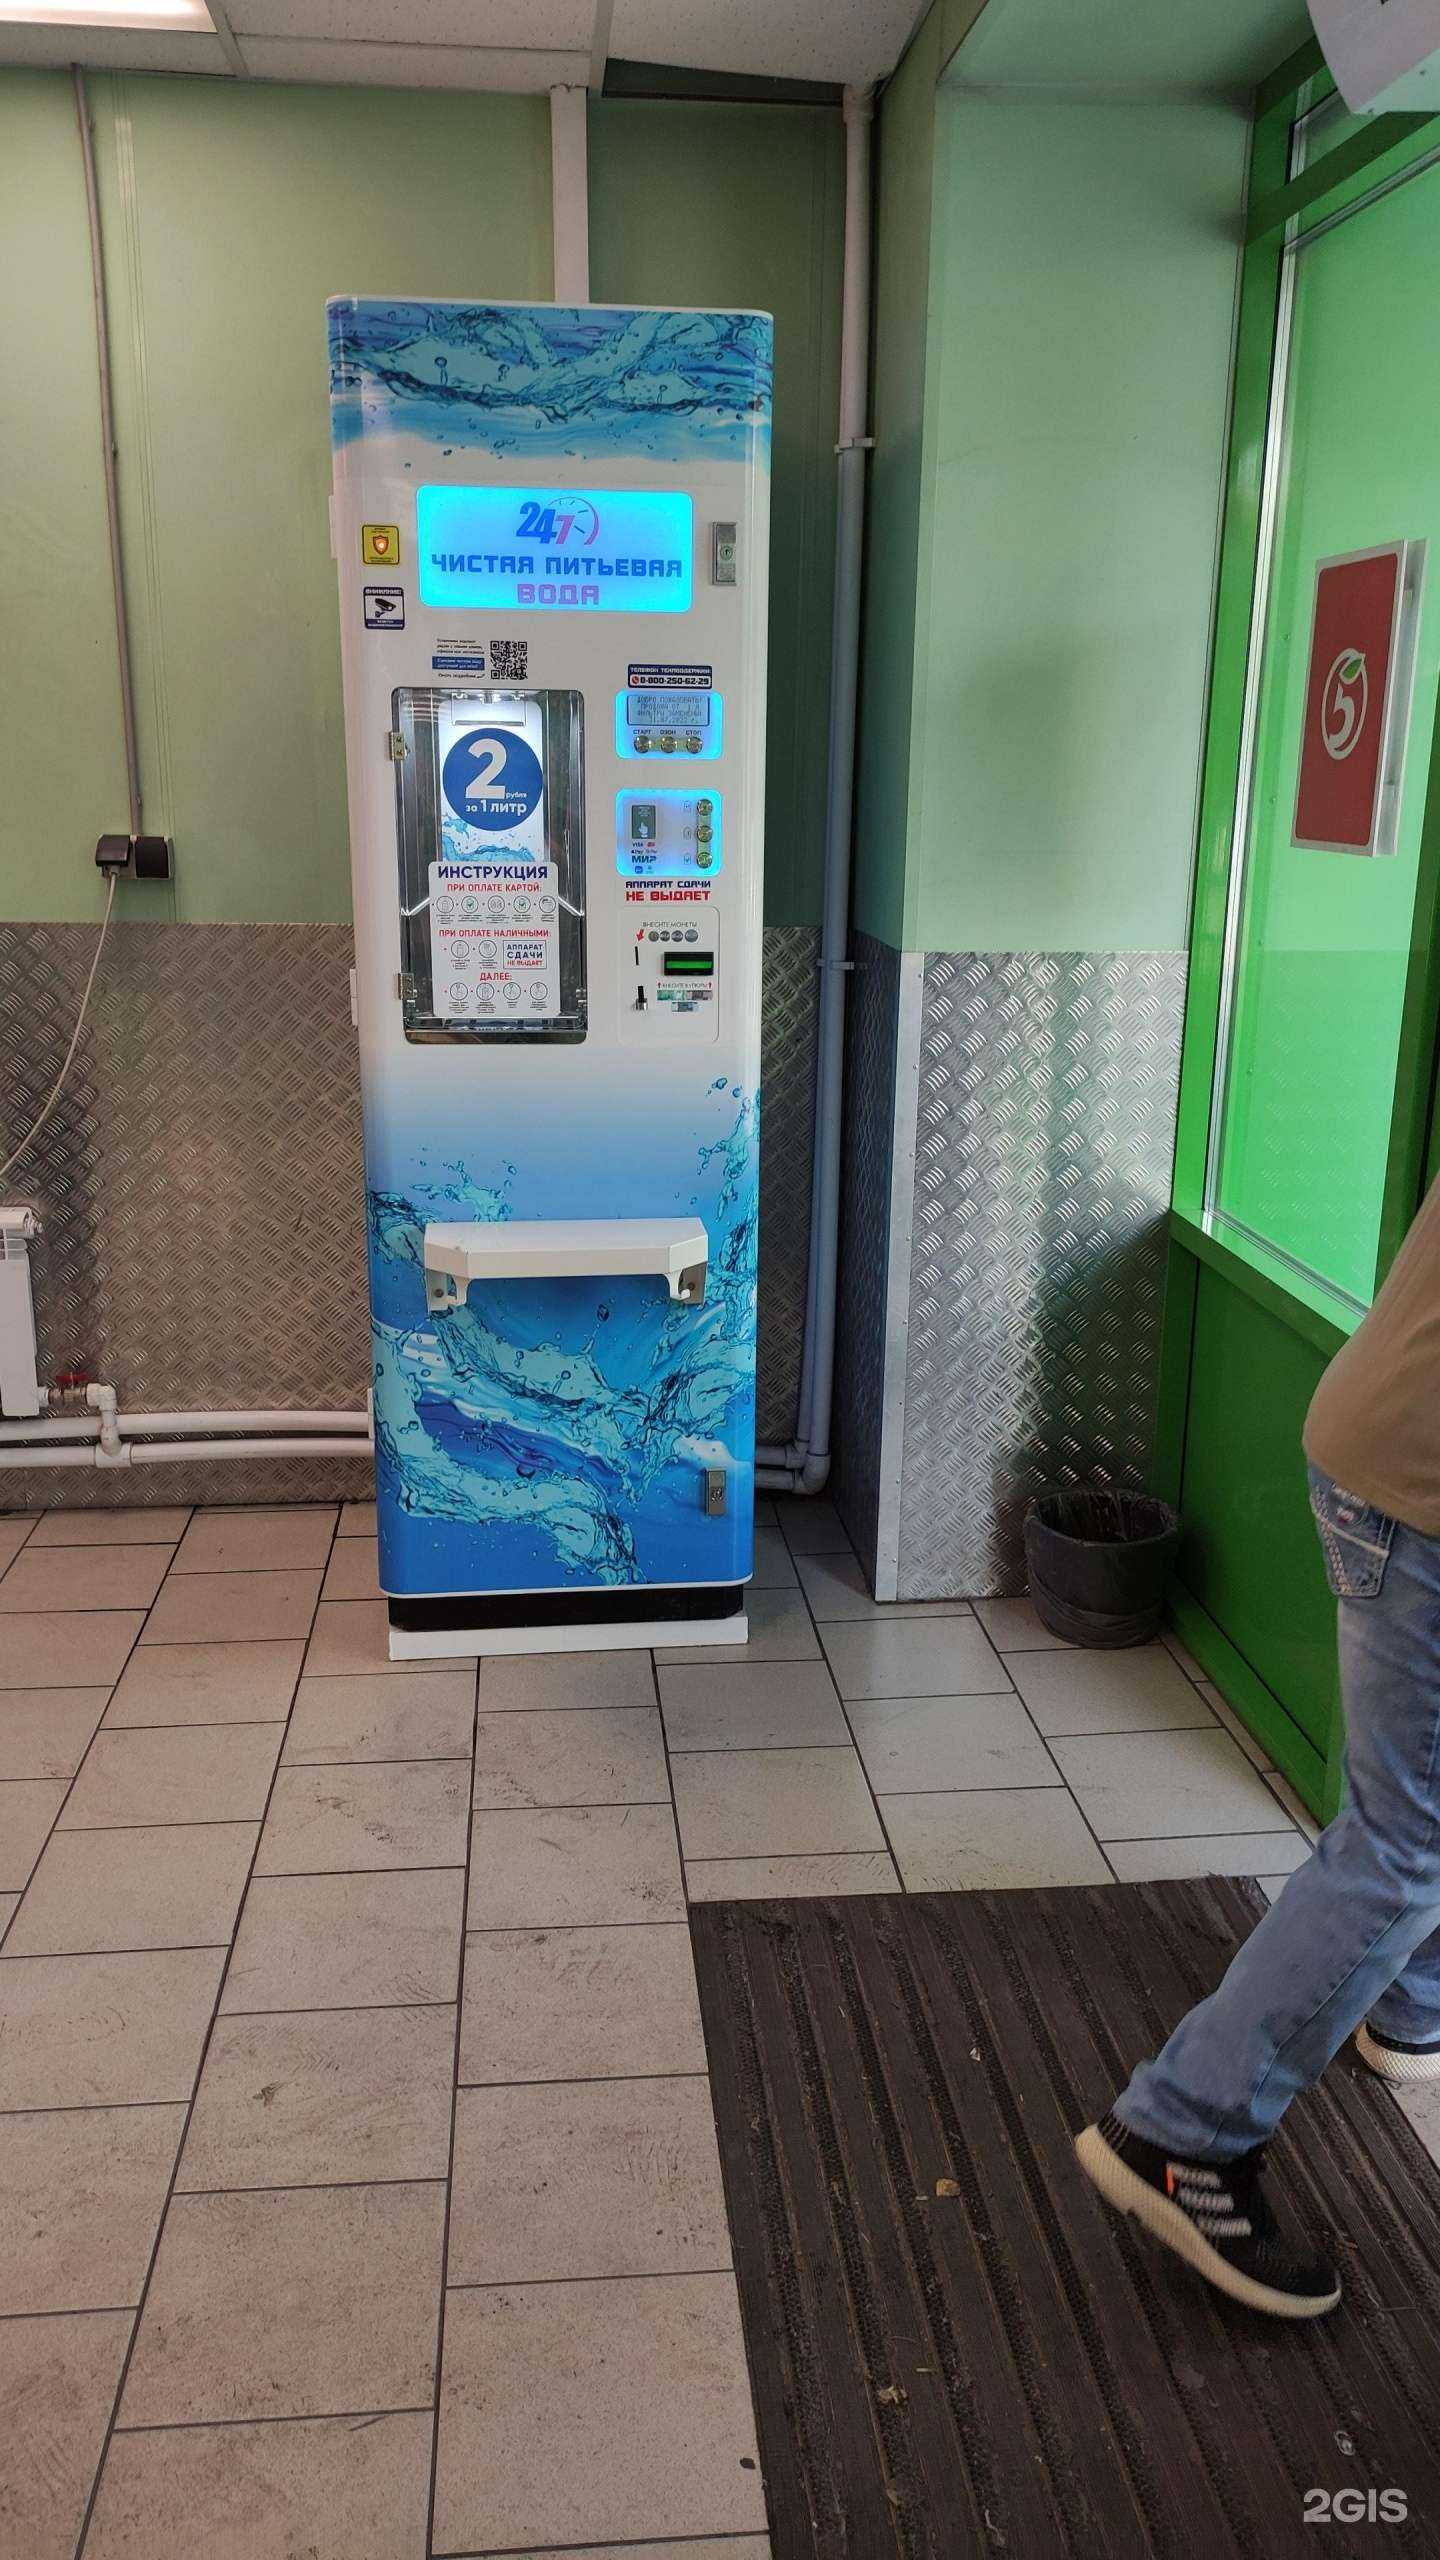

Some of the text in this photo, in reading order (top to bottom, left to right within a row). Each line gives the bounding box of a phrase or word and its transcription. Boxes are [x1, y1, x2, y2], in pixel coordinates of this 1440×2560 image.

[431, 553, 682, 578] ЧИСТАЯ ПИТЬЕВАЯ
[517, 583, 599, 605] ВОДА
[640, 677, 709, 685] 8-800-250-62-29
[466, 738, 506, 799] 2
[480, 800, 488, 812] 1
[490, 804, 527, 816] литр
[438, 866, 548, 880] ИНСТРУКЦИЯ
[505, 884, 541, 892] КАРТОЙ:
[626, 892, 710, 901] НЕ ВЫДАЕТ
[507, 952, 543, 960] СДАЧИ
[480, 973, 512, 981] ДАЛЕЕ:
